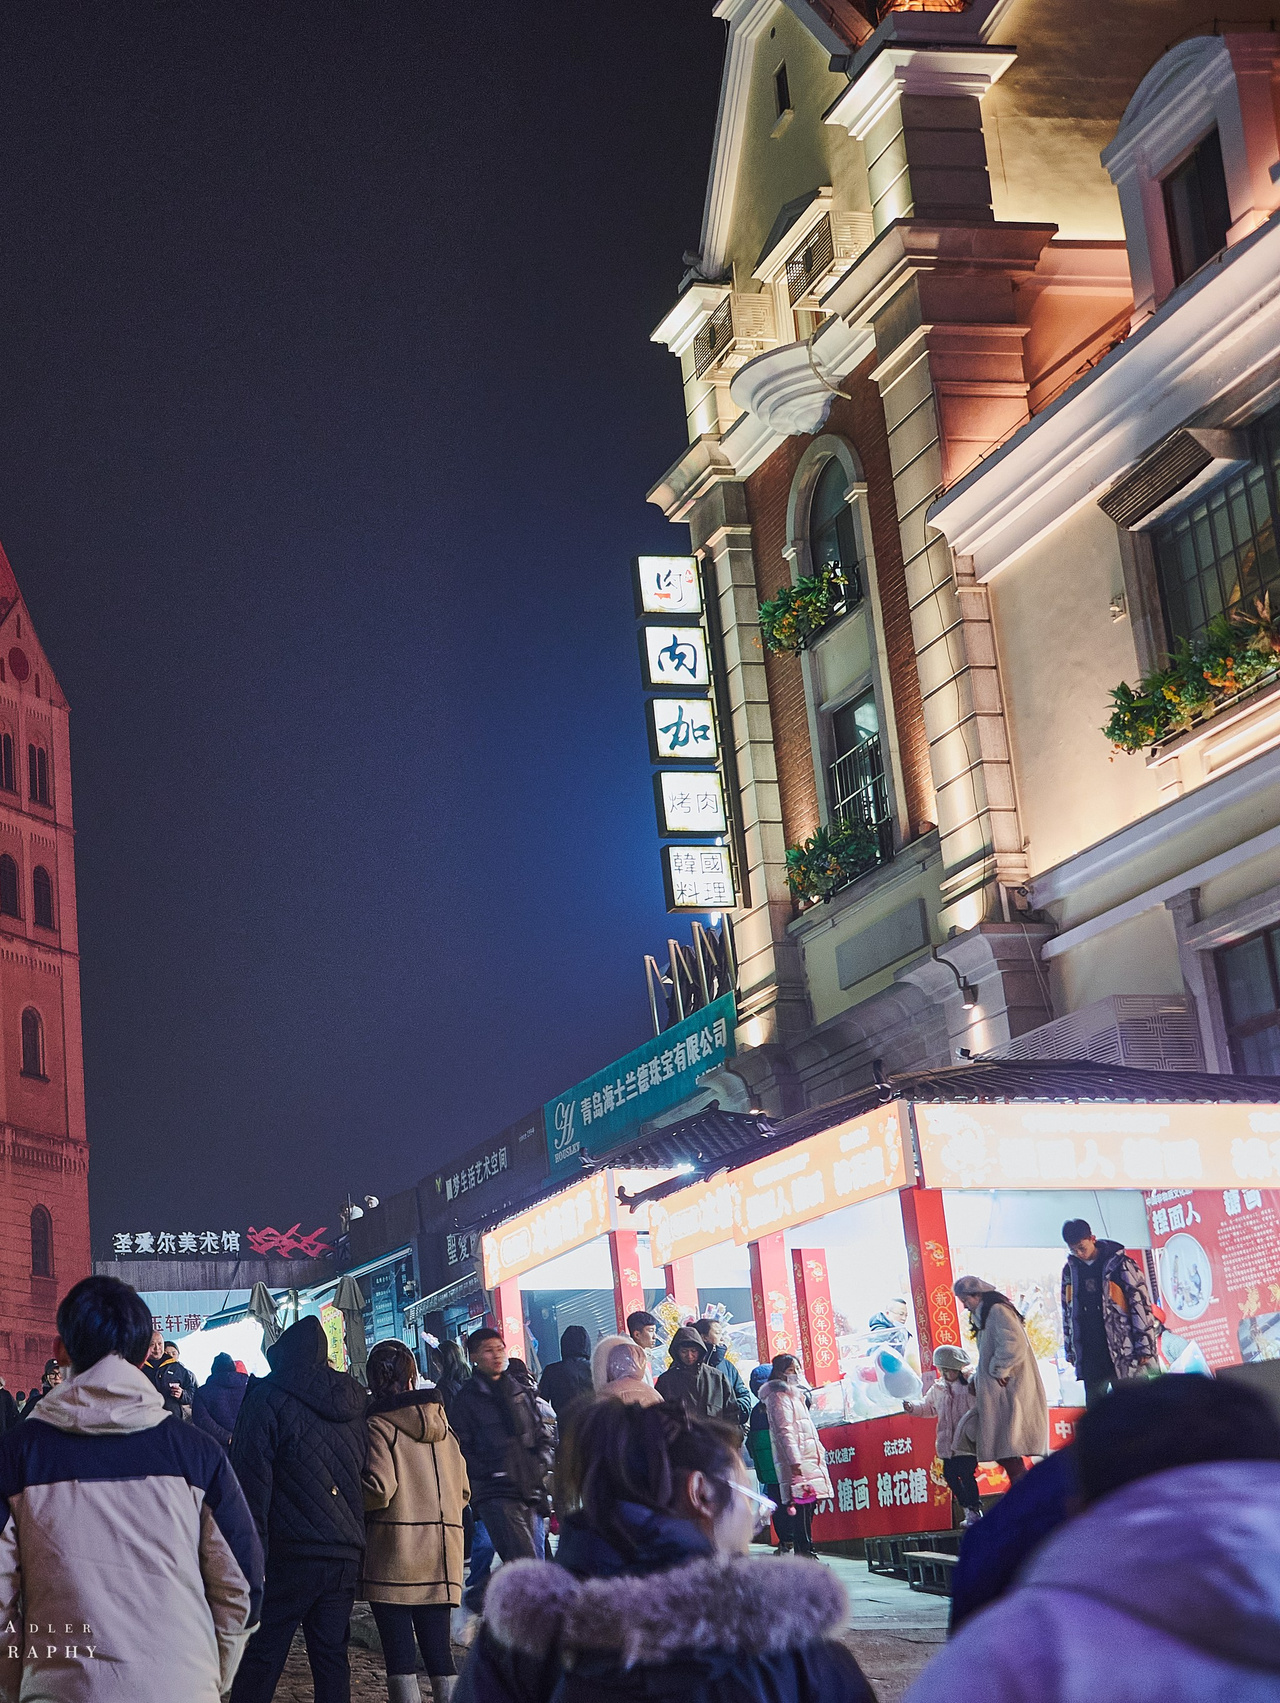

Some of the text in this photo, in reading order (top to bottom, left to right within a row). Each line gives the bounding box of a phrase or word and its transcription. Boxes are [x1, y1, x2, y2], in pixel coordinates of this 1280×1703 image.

[668, 791, 719, 814] 烤肉
[673, 852, 724, 875] 韓國
[676, 881, 729, 904] 料理
[1151, 1200, 1202, 1236] 捏面人
[113, 1230, 241, 1254] 圣爱尔美术馆
[152, 1313, 212, 1333] 玉轩藏
[814, 1303, 831, 1359] 新年快乐
[883, 1436, 913, 1457] 花式艺术
[837, 1475, 870, 1513] 糖画
[876, 1467, 929, 1508] 棉花糖
